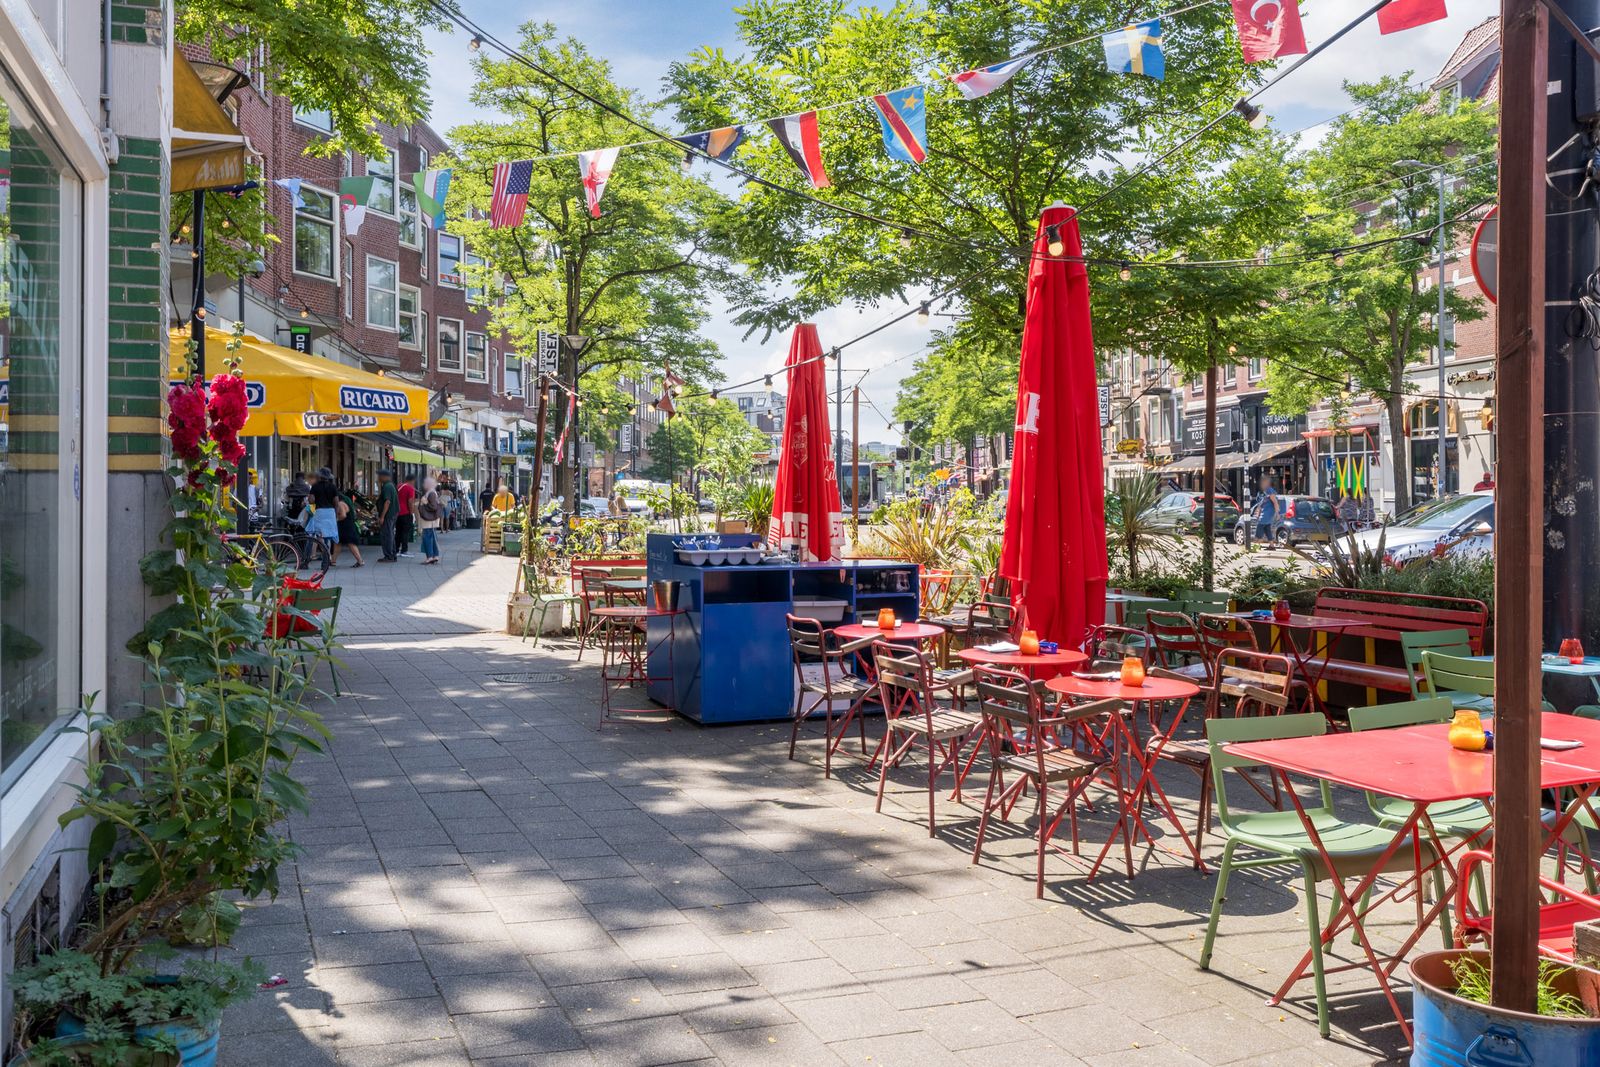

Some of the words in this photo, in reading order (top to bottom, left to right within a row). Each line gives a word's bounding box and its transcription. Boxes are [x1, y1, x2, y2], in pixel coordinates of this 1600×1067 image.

[195, 156, 240, 182] Asahi
[343, 390, 406, 411] RICARD
[1266, 424, 1289, 435] FASHION
